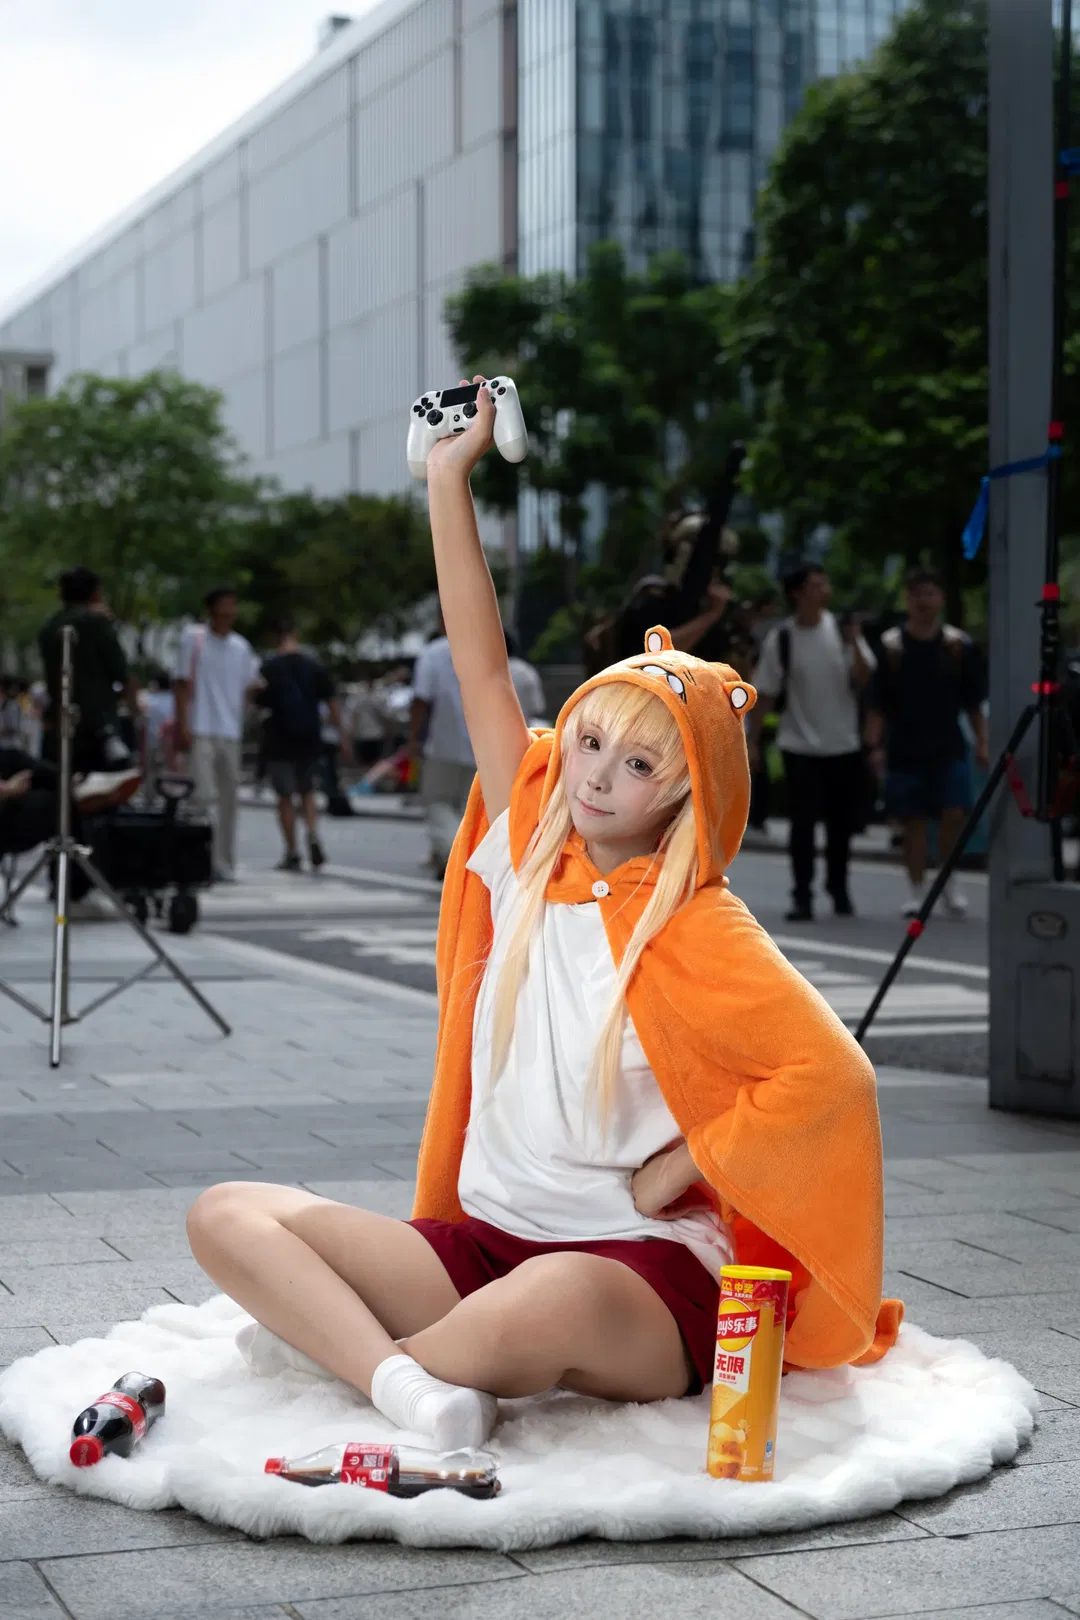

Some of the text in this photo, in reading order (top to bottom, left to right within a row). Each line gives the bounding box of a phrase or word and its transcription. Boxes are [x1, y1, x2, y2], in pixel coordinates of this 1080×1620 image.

[717, 1316, 757, 1336] ay's 乐事
[716, 1353, 745, 1374] 无限
